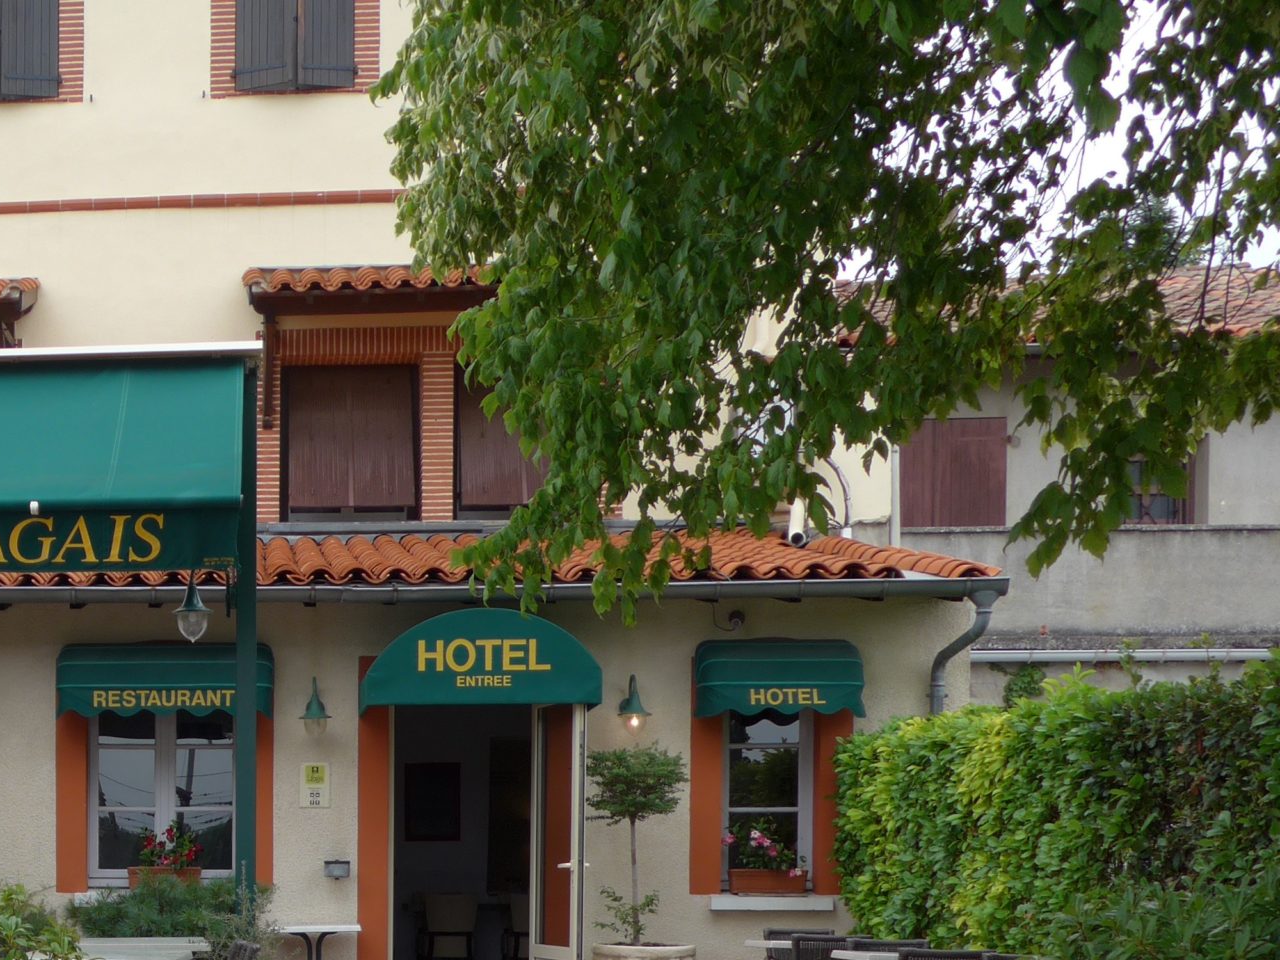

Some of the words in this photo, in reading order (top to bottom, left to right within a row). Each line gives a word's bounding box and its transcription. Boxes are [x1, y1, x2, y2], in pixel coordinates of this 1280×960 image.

[417, 637, 552, 673] HOTEL
[456, 675, 512, 687] ENTREE
[93, 689, 236, 708] RESTAURANT
[750, 687, 827, 705] HOTEL
